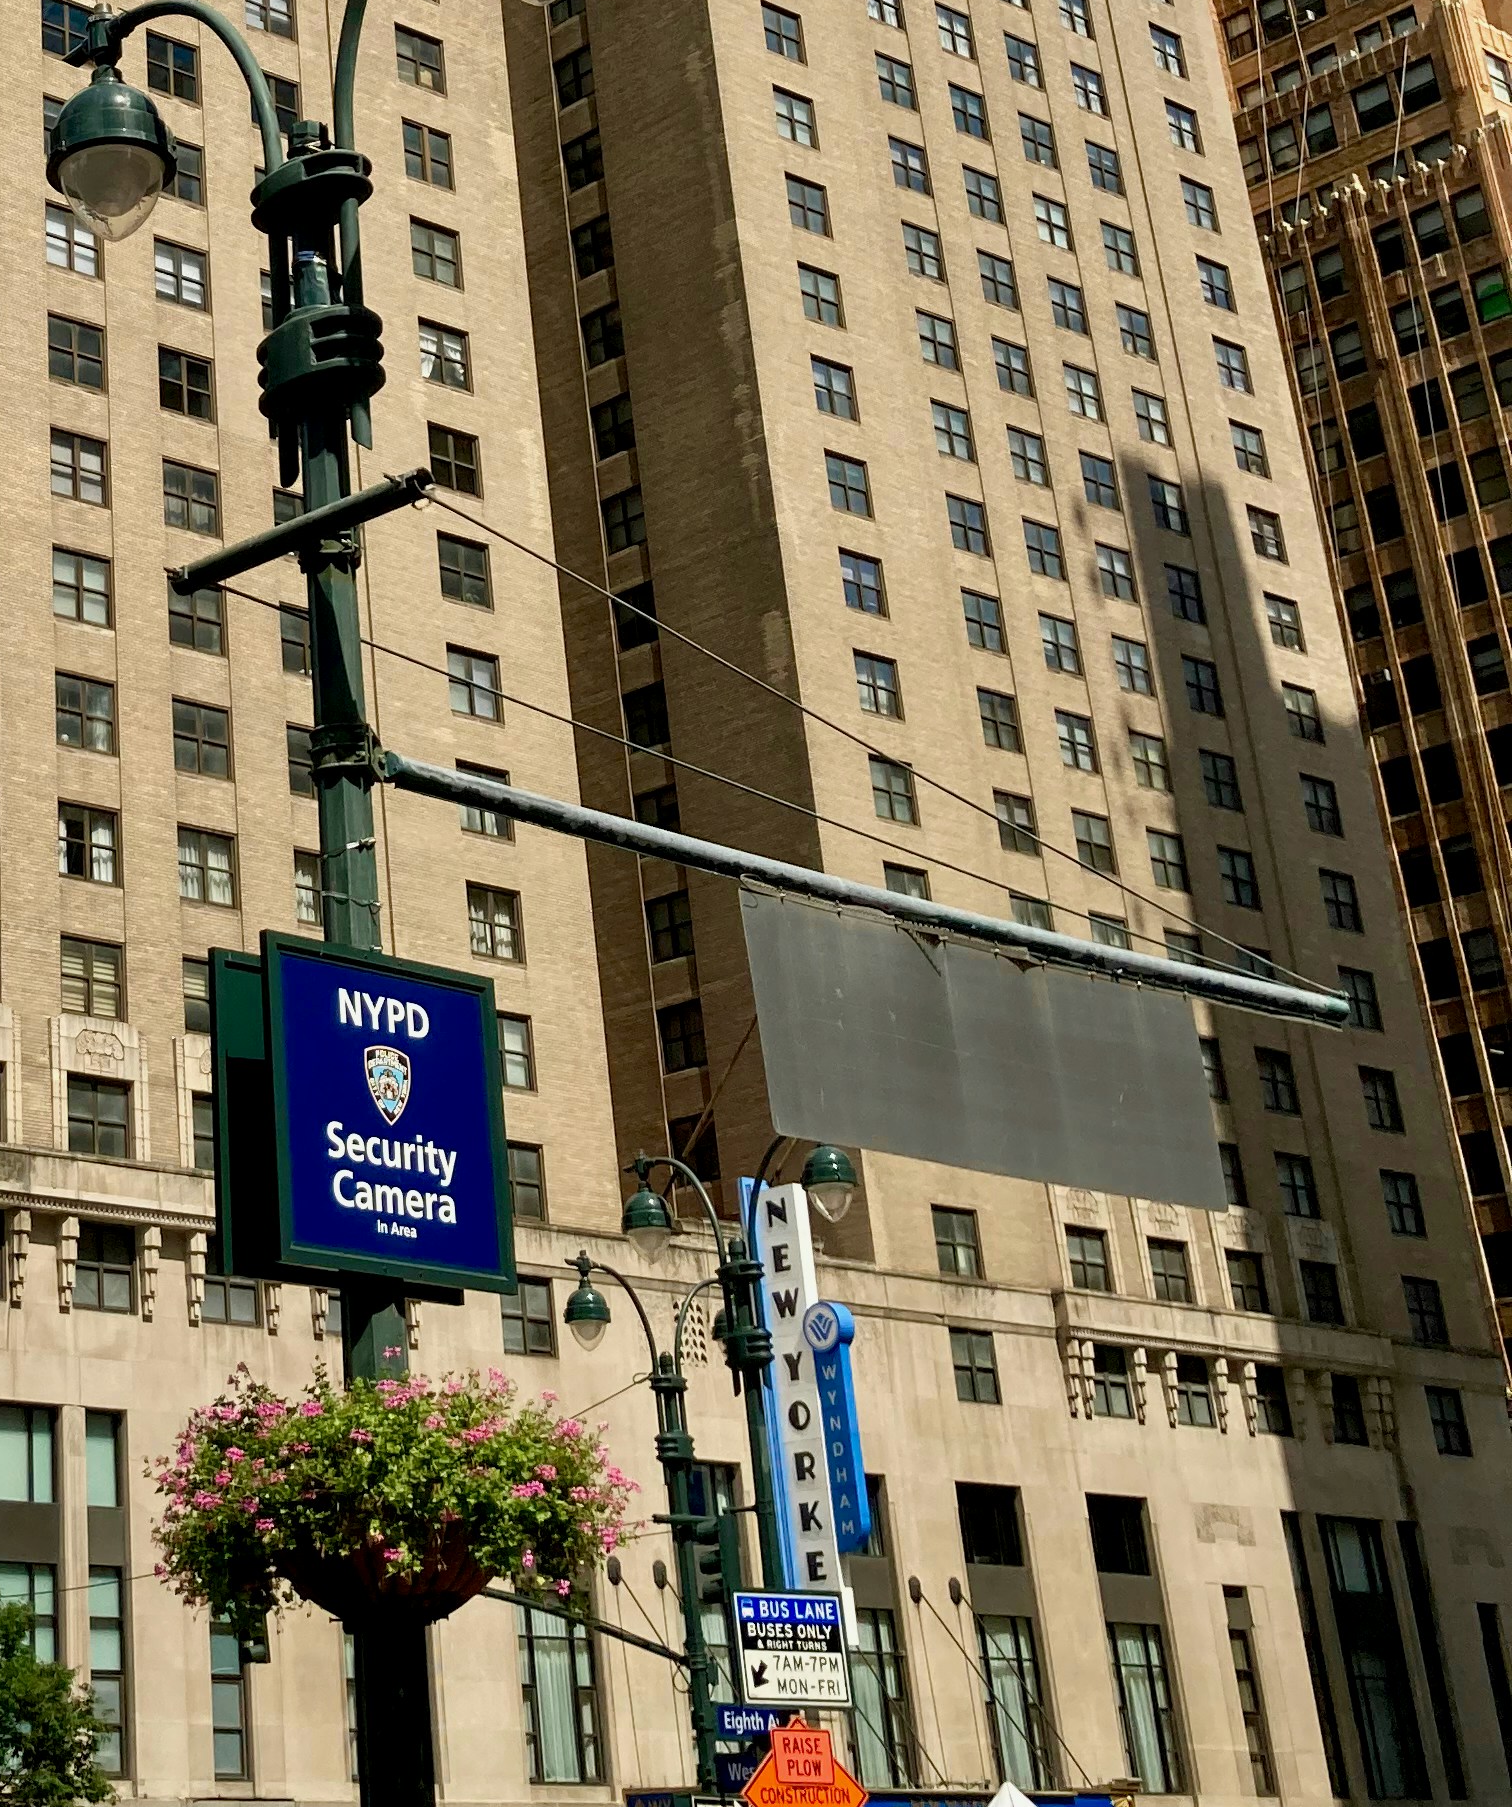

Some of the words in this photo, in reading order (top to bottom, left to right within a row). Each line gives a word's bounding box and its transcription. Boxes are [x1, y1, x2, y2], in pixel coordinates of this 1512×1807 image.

[337, 987, 430, 1039] NYPD
[327, 1120, 457, 1187] Security
[333, 1169, 457, 1224] Camera
[376, 1219, 388, 1234] In
[390, 1221, 418, 1239] Area
[765, 1196, 800, 1319] NEW
[821, 1364, 855, 1536] WYNDHAM
[781, 1350, 828, 1582] YORKE
[758, 1599, 790, 1619] BUS
[794, 1601, 836, 1620] LANE
[746, 1622, 794, 1638] BUSES
[796, 1623, 833, 1640] ONLY
[756, 1638, 765, 1649] &
[766, 1639, 794, 1650] RIGHT
[796, 1640, 828, 1652] TURNS
[772, 1654, 840, 1673] 7AM-7PM
[777, 1677, 841, 1696] MON-FRI
[723, 1710, 765, 1736] Eighth
[782, 1737, 824, 1756] RAISE
[787, 1759, 823, 1777] PLOW
[759, 1786, 851, 1805] CONSTRUCTION
